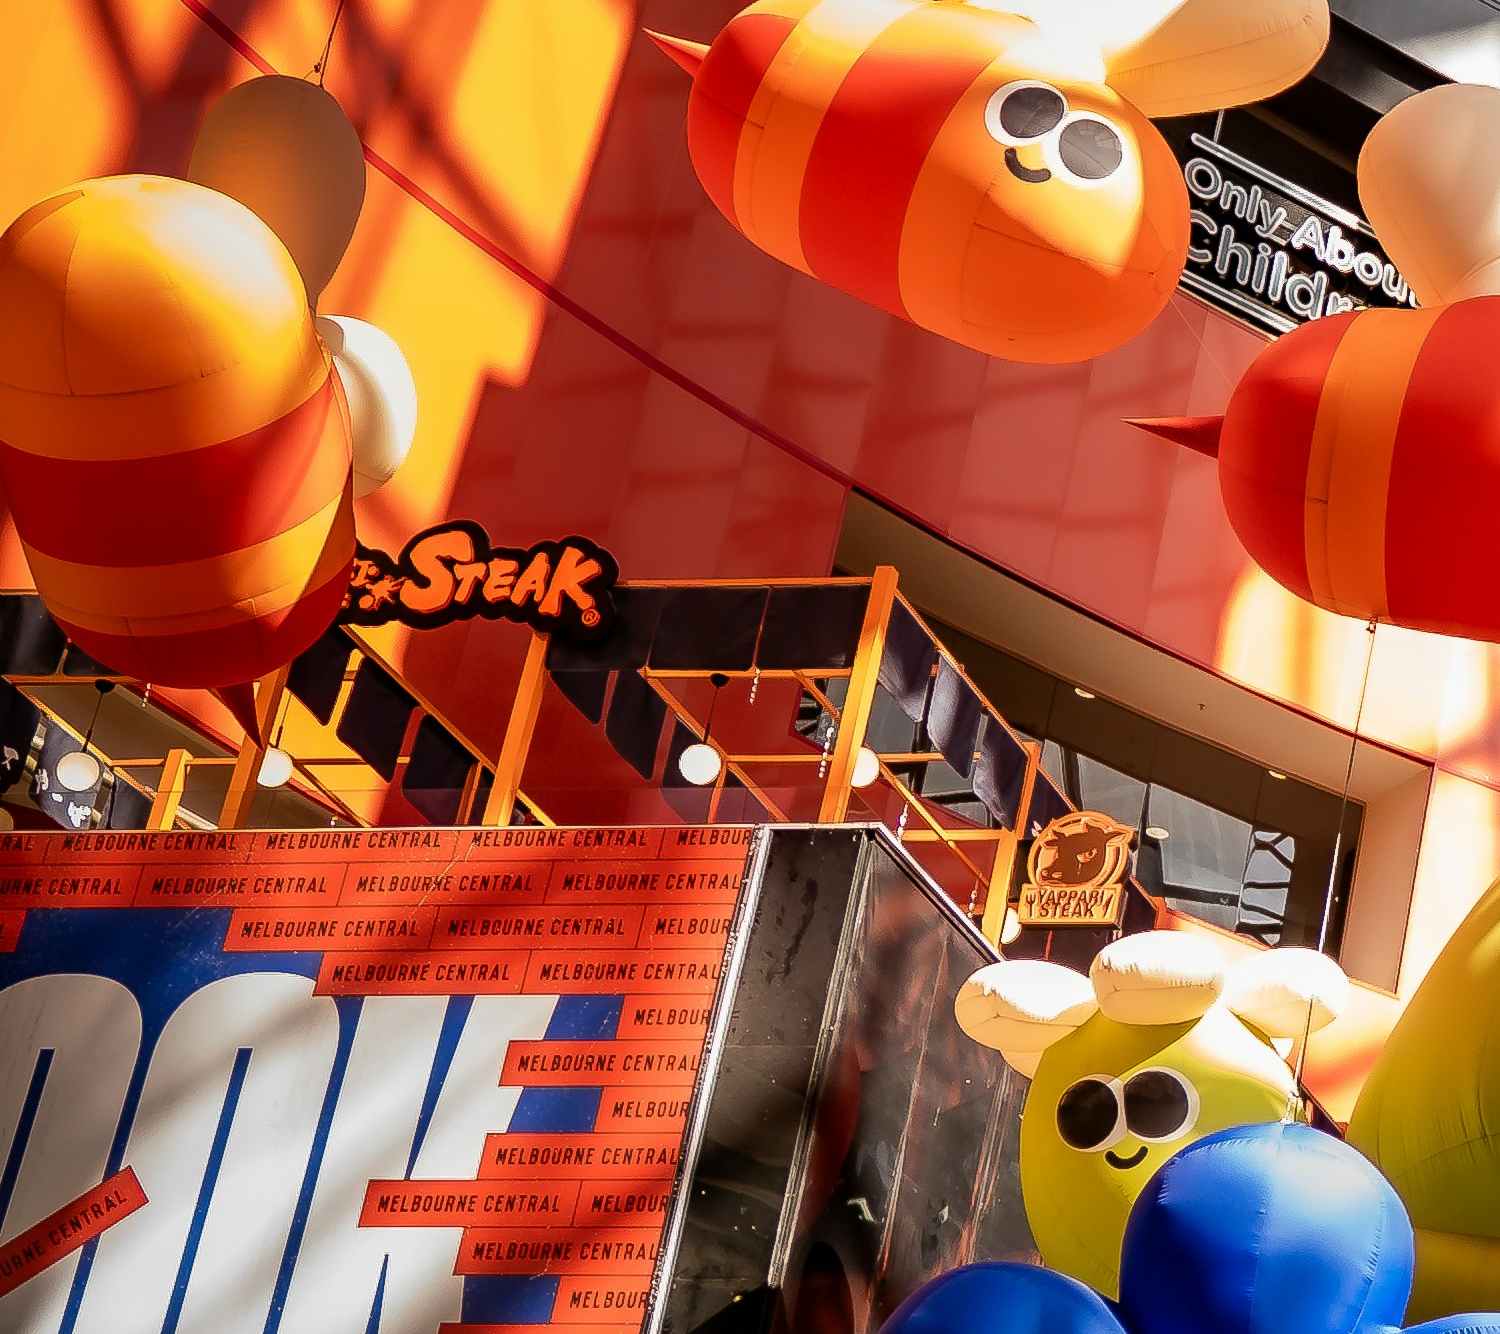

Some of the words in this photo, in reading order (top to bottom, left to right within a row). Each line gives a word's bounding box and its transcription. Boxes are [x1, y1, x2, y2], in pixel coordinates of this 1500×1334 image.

[1184, 157, 1287, 245] Only
[61, 832, 156, 851] MELBOURNE
[163, 833, 237, 851] CENTRAL
[266, 832, 361, 850] MELBOURNE
[367, 831, 441, 849] CENTRAL
[472, 830, 568, 847] MELBOURNE
[572, 829, 648, 847] CENTRAL
[48, 877, 122, 895] CENTRAL
[150, 876, 248, 895] MELBOURNE
[253, 876, 327, 894] CENTRAL
[356, 875, 452, 893] MELBOURNE
[458, 874, 533, 892] CENTRAL
[562, 873, 660, 891] MELBOURNE
[665, 873, 741, 890] CENTRAL
[1040, 889, 1105, 905] YAPPARI
[1039, 903, 1095, 918] STEAK
[240, 921, 337, 939] MELBOURNE
[343, 919, 418, 938] CENTRAL
[447, 918, 546, 937] MELBOURNE
[550, 918, 625, 936] CENTRAL
[332, 964, 430, 983] MELBOURNE
[435, 963, 511, 982] CENTRAL
[539, 963, 637, 982] MELBOURNE
[643, 962, 719, 981] CENTRAL
[517, 1053, 615, 1072] MELBOURNE
[621, 1053, 700, 1072] CENTRAL
[495, 1147, 594, 1166] MELBOURNE
[601, 1147, 679, 1166] CENTRAL
[377, 1194, 478, 1214] MELBOURNE
[483, 1194, 561, 1213] CENTRAL
[48, 1189, 128, 1247] CENTRAL
[471, 1242, 574, 1262] MELBOURNE
[579, 1242, 658, 1261] CENTRAL
